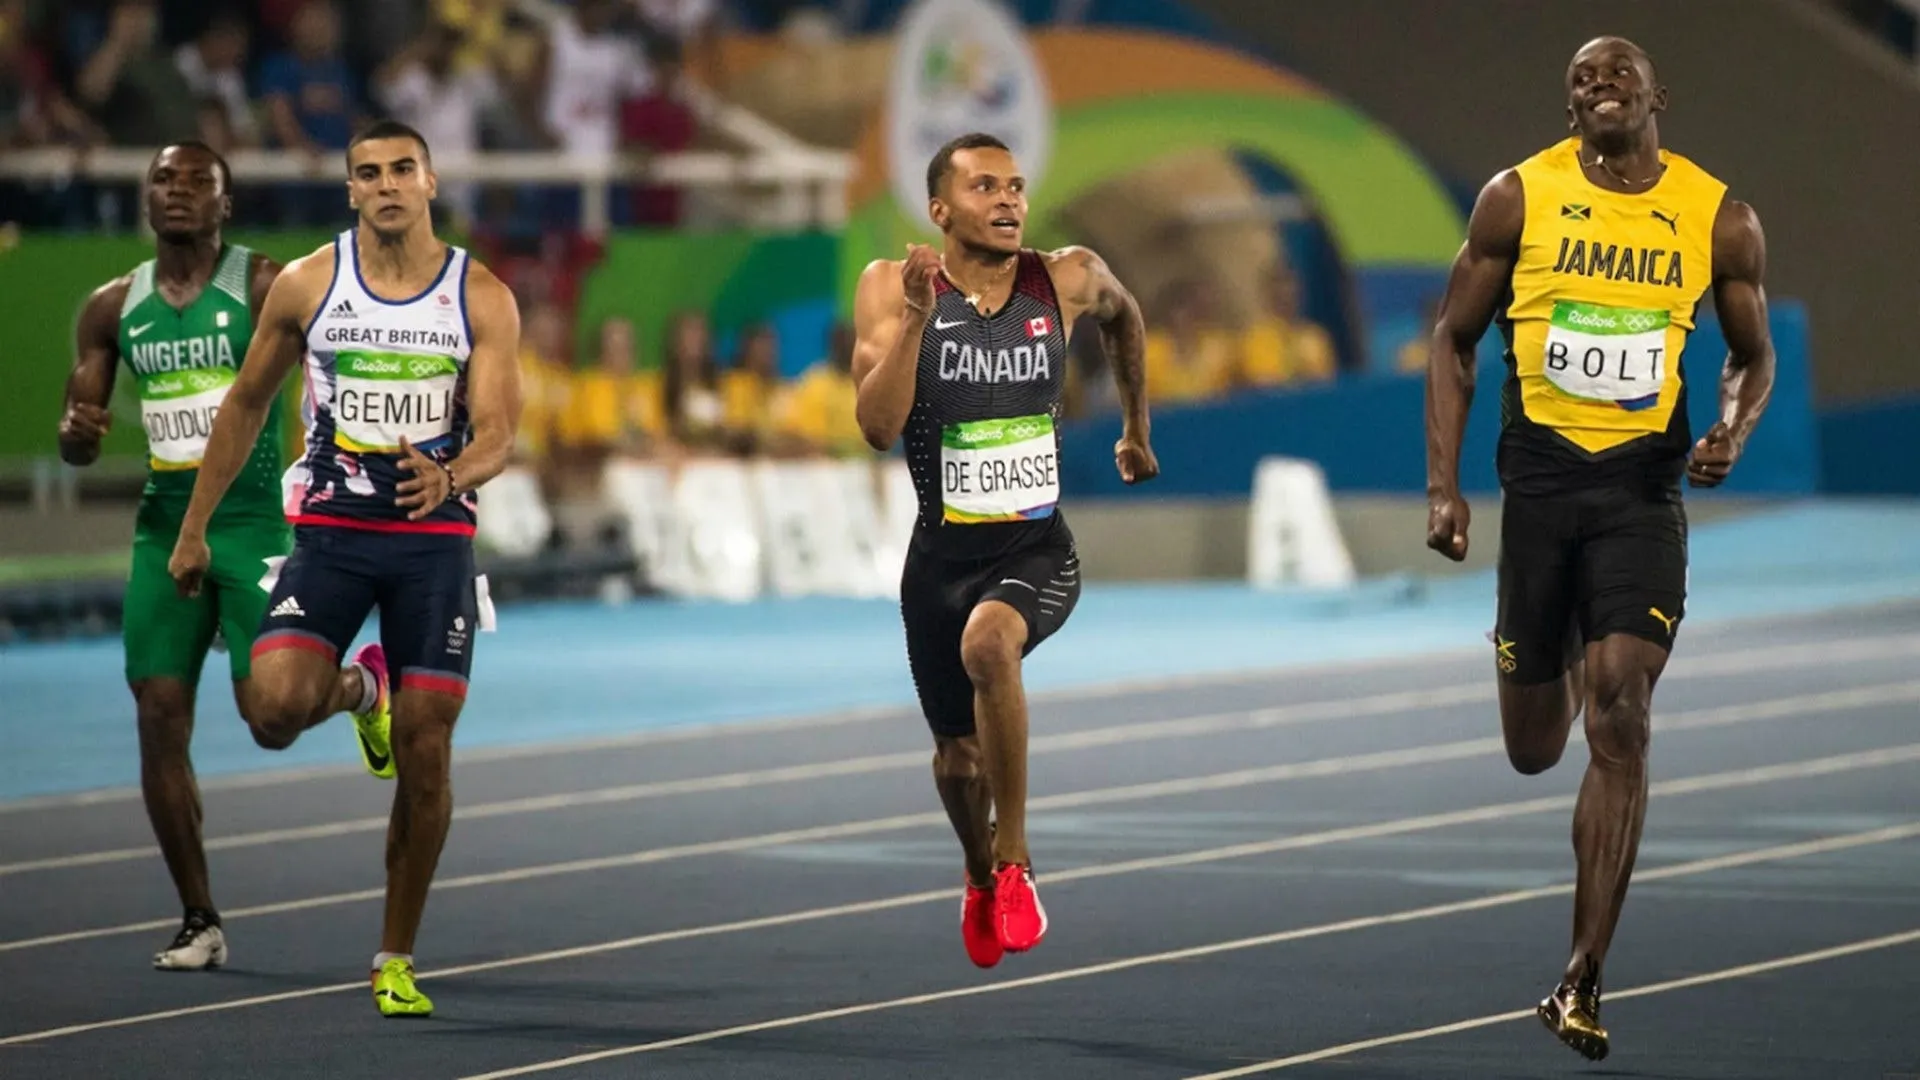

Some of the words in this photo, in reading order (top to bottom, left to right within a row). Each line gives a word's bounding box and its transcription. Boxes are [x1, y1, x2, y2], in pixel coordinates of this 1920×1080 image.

[1552, 237, 1683, 288] JAMAICA
[131, 333, 235, 375] NIGERIA
[325, 327, 383, 342] GREAT
[388, 329, 460, 348] BRITAIN
[938, 340, 1050, 384] CANADA
[1547, 341, 1664, 381] BOLT
[340, 389, 449, 424] GEMILI
[945, 461, 971, 493] DE
[979, 454, 1056, 493] GRASSE
